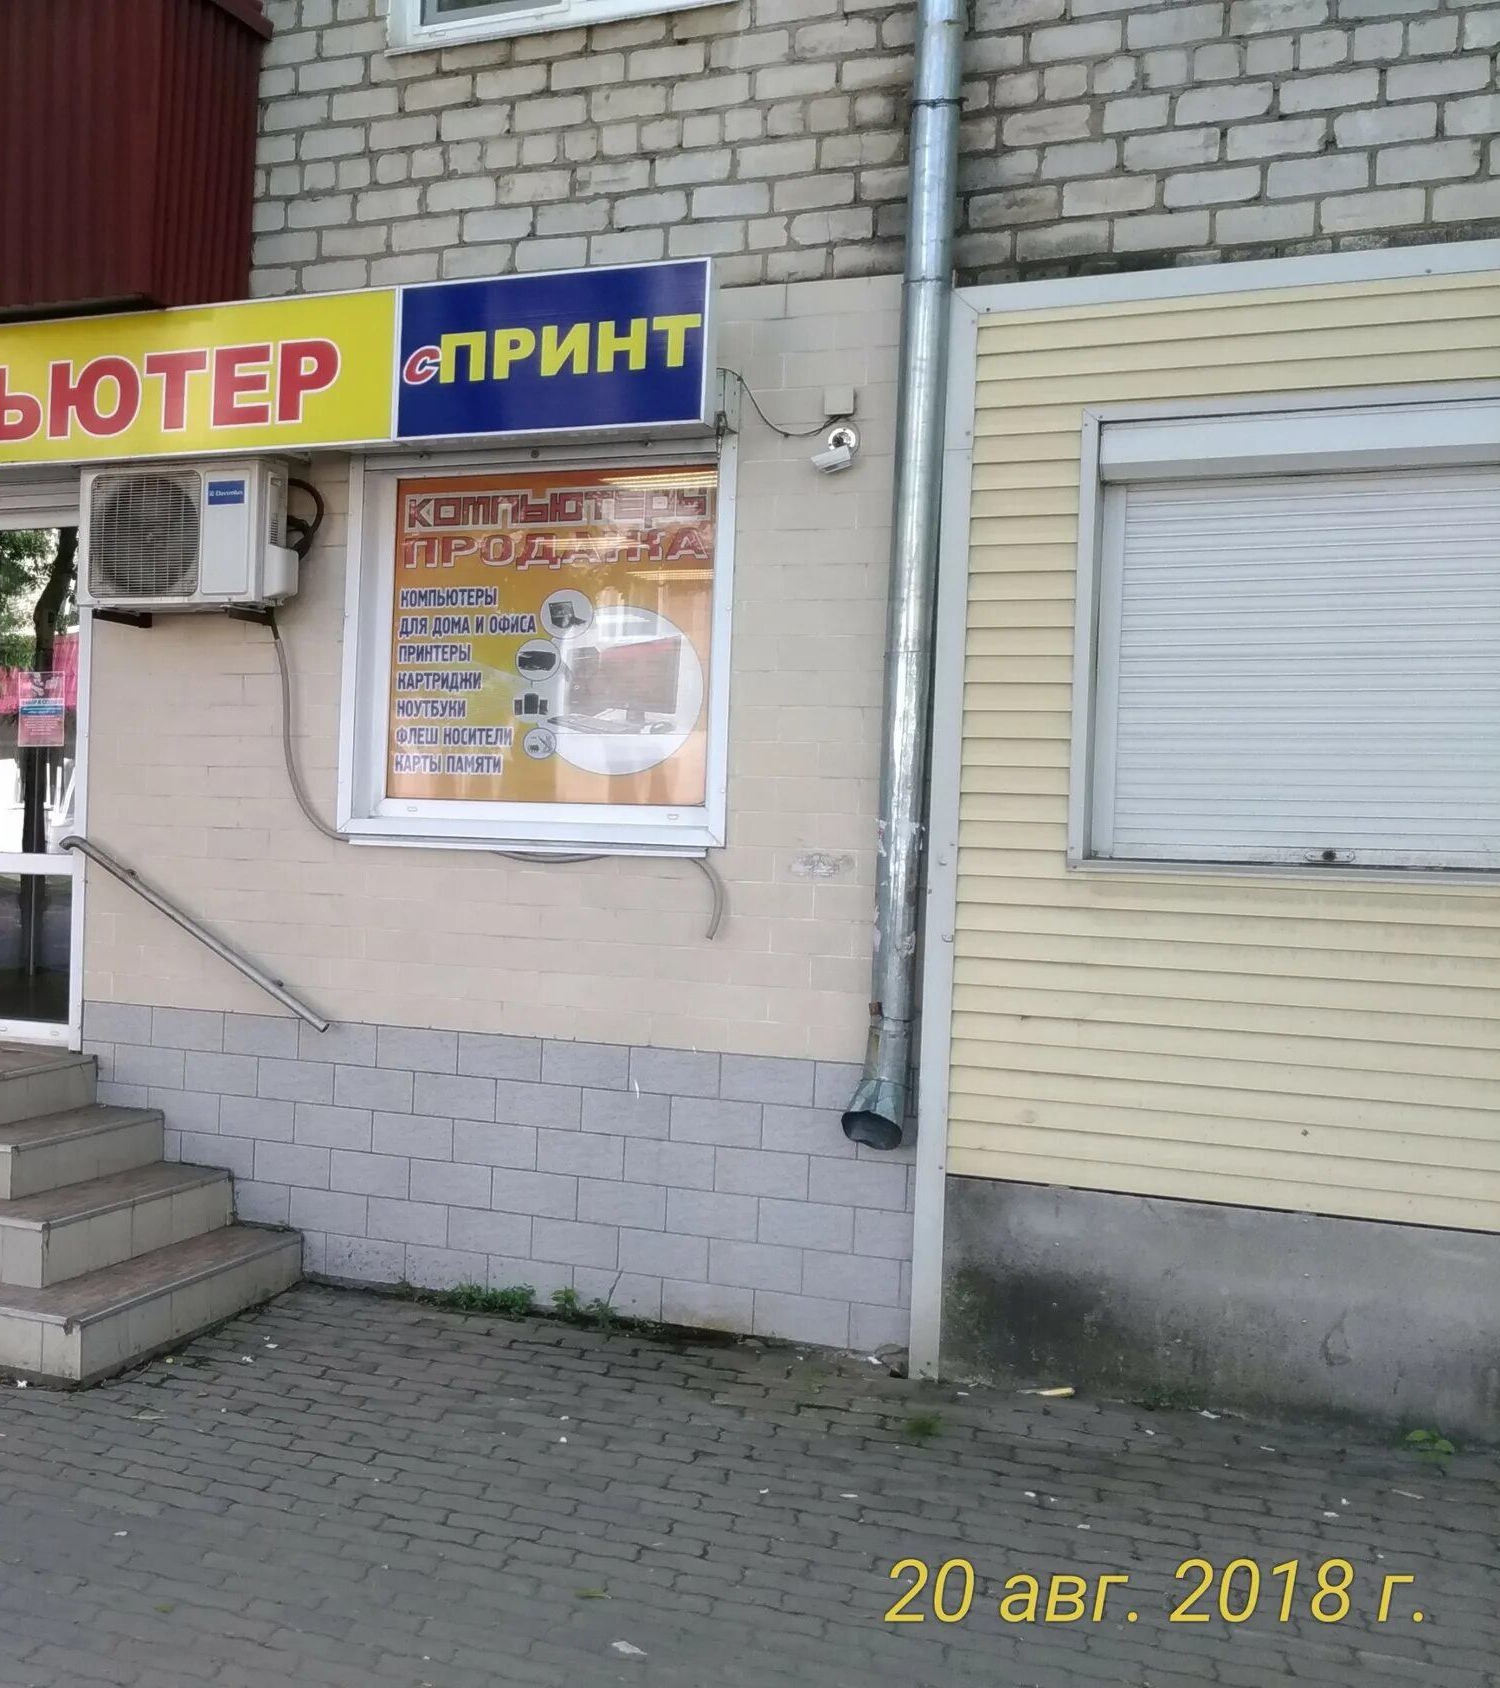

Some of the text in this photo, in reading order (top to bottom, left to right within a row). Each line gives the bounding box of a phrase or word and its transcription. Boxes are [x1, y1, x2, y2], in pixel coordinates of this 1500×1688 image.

[405, 487, 710, 530] КОМПЬЮТЕРЫ
[404, 526, 710, 570] ПРОДАЖА
[400, 588, 498, 608] КОМПЬЮТЕРЫ
[399, 614, 537, 638] ДЛЯ ДОМА И ОФИСА
[398, 644, 472, 662] ПРИНТЕРЫ
[397, 671, 482, 692] КАРТРИДЖИ
[396, 699, 467, 718] НОУТБУКИ
[395, 727, 513, 747] ФЛЕШ НОСИТЕЛИ
[394, 755, 502, 774] КАРТЫ ПАМЯТИ
